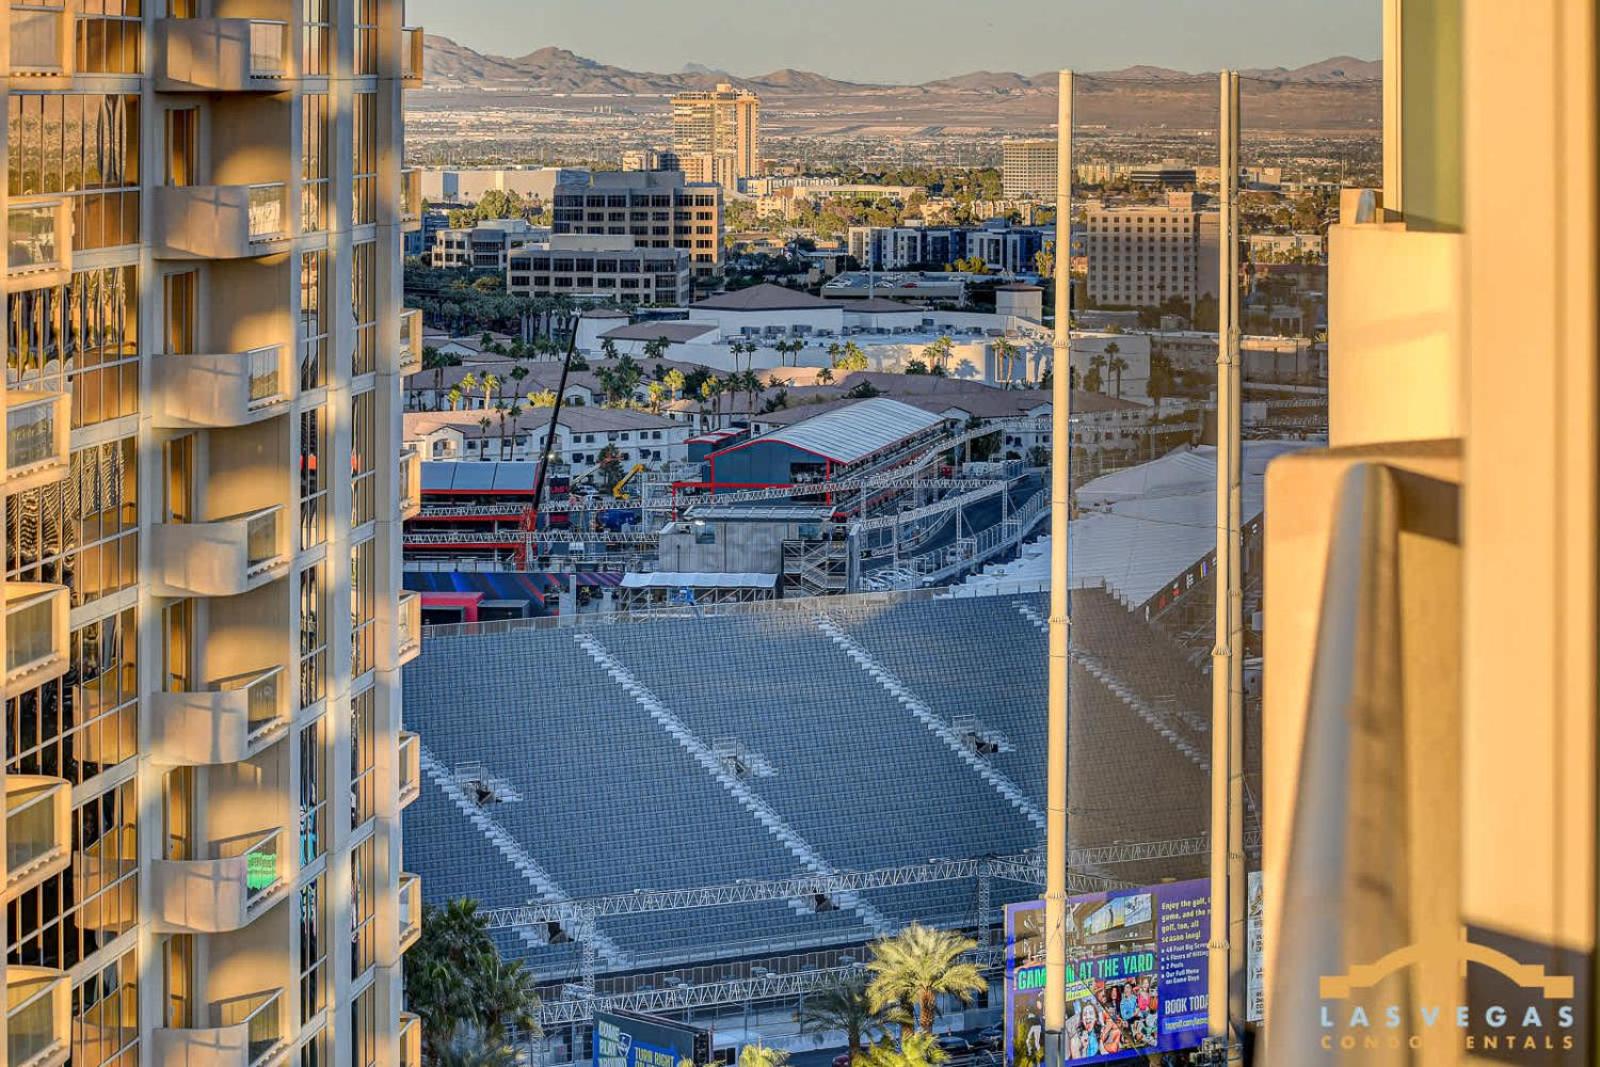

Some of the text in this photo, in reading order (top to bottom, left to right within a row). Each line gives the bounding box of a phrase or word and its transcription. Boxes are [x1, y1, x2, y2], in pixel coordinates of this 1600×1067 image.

[1162, 902, 1180, 911] Enjoy
[1192, 897, 1207, 908] golf,
[1162, 912, 1182, 923] game,
[1182, 910, 1195, 918] and
[1195, 908, 1206, 917] the
[1190, 920, 1200, 928] all
[1162, 930, 1201, 943] season long!
[1017, 966, 1047, 991] GAM
[1079, 961, 1094, 981] AT
[1097, 957, 1119, 978] THE
[1123, 953, 1154, 975] YARD
[1165, 970, 1175, 978] Our
[1175, 969, 1185, 977] Full
[1187, 975, 1200, 983] Days
[1165, 997, 1188, 1015] BOOK
